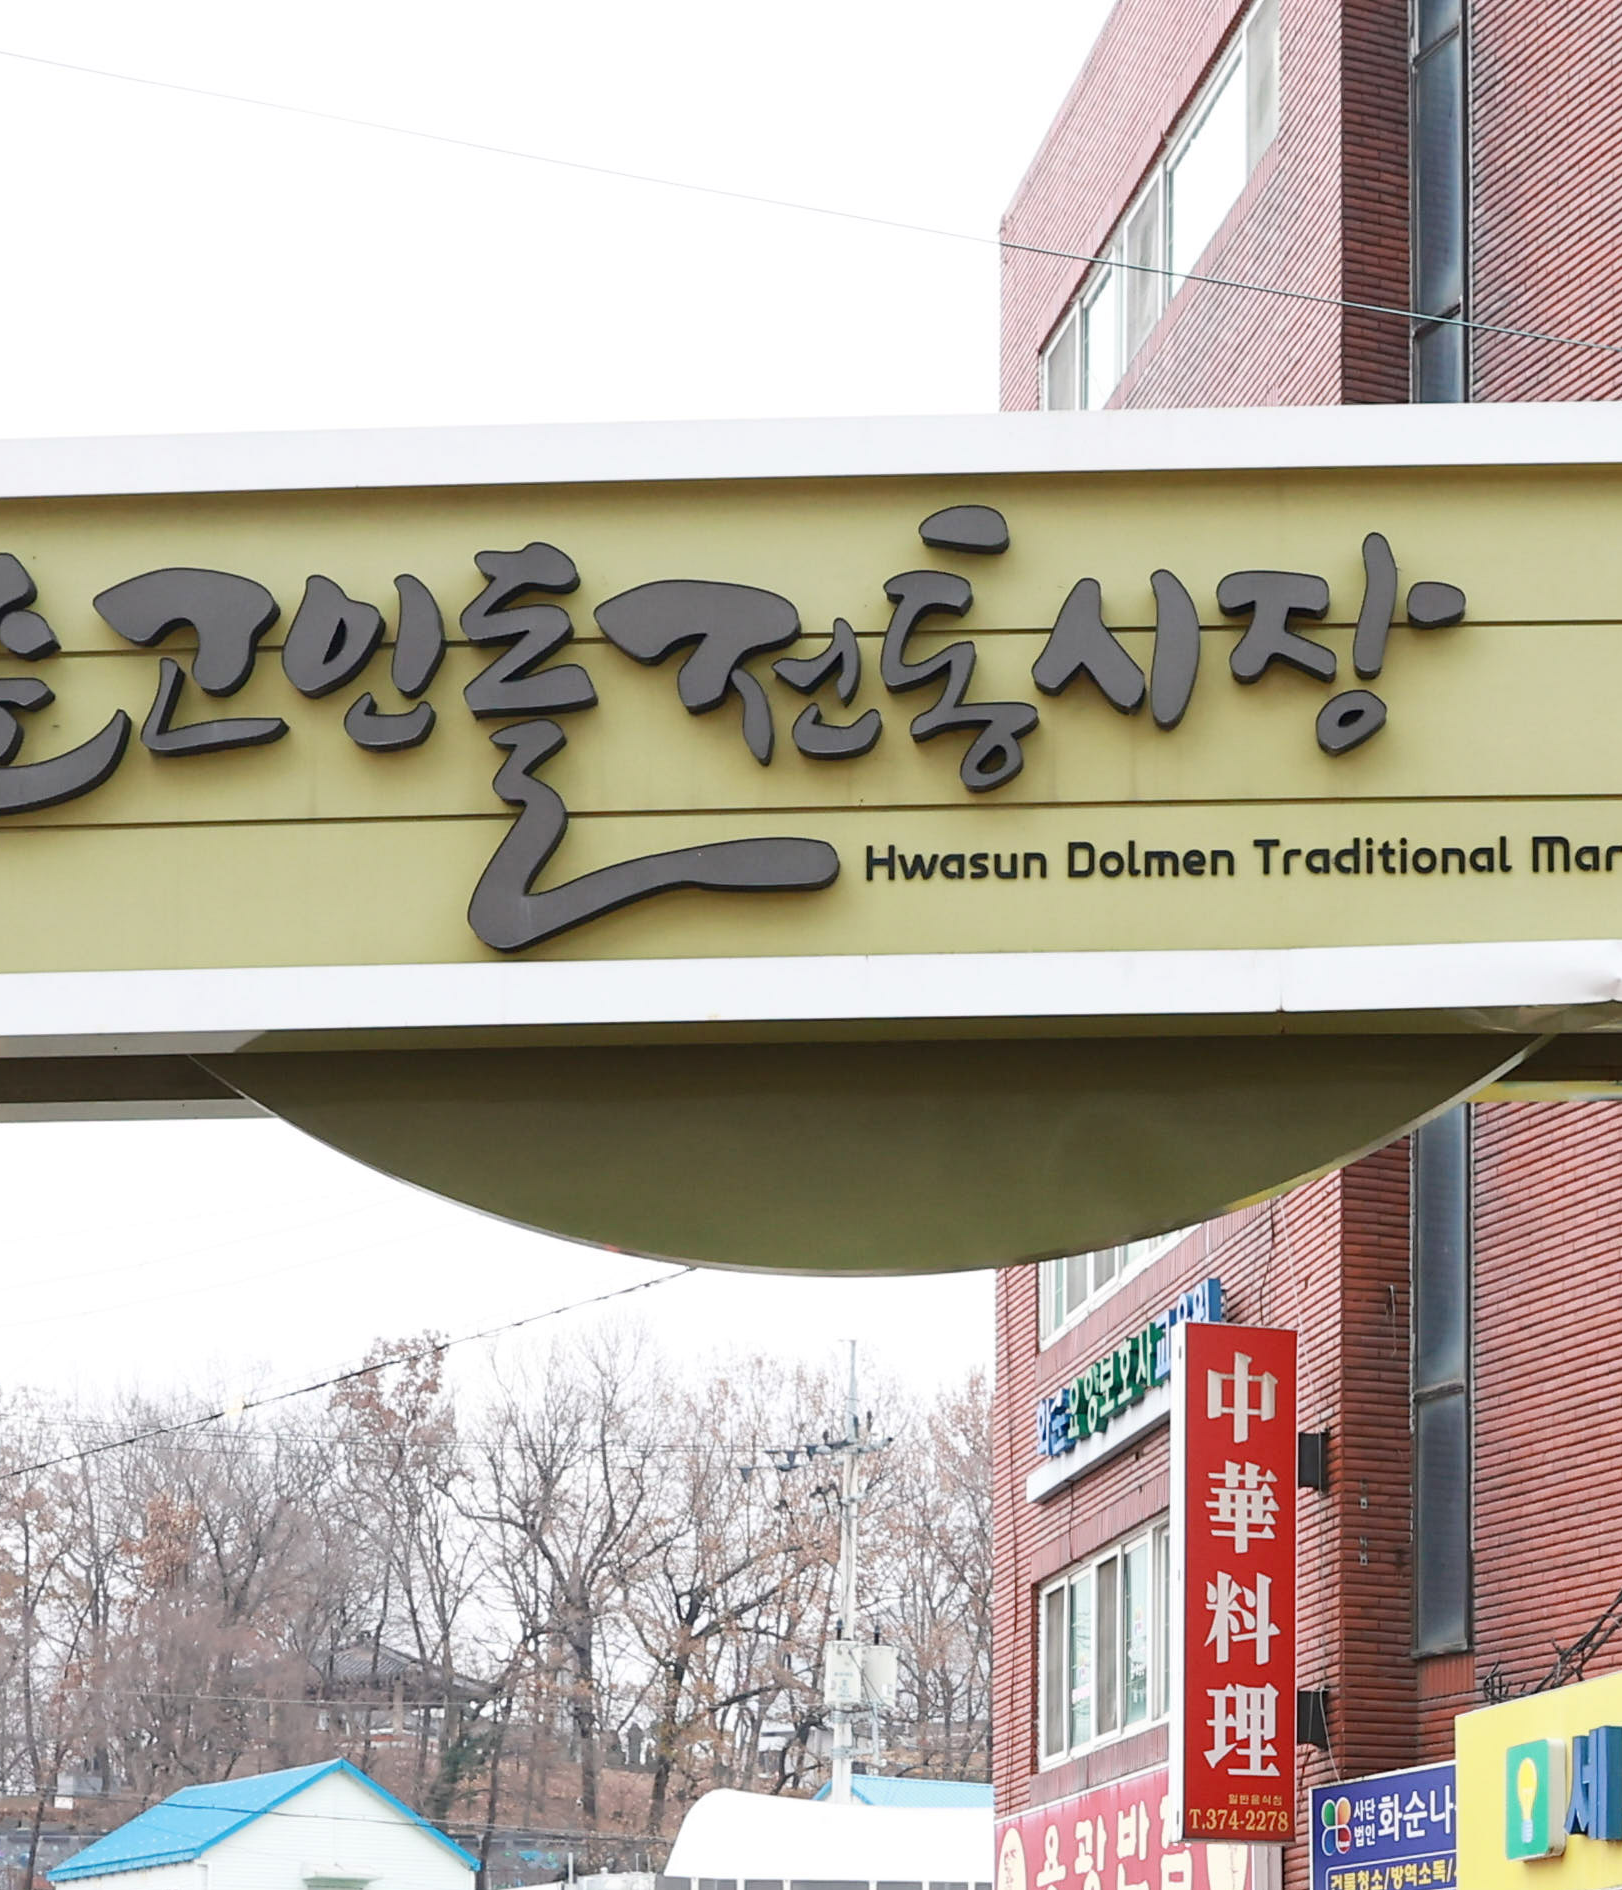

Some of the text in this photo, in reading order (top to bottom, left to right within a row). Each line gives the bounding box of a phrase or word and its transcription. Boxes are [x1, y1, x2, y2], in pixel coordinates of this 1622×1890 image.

[864, 843, 1049, 883] Hwasun
[1067, 840, 1235, 879] Dolmen
[1254, 838, 1512, 876] Traditional
[1204, 1351, 1281, 1777] 中華料理
[1189, 1808, 1289, 1833] T.374-2278
[1353, 1784, 1456, 1842] 사단 화순나
[1353, 1823, 1376, 1848] 법인
